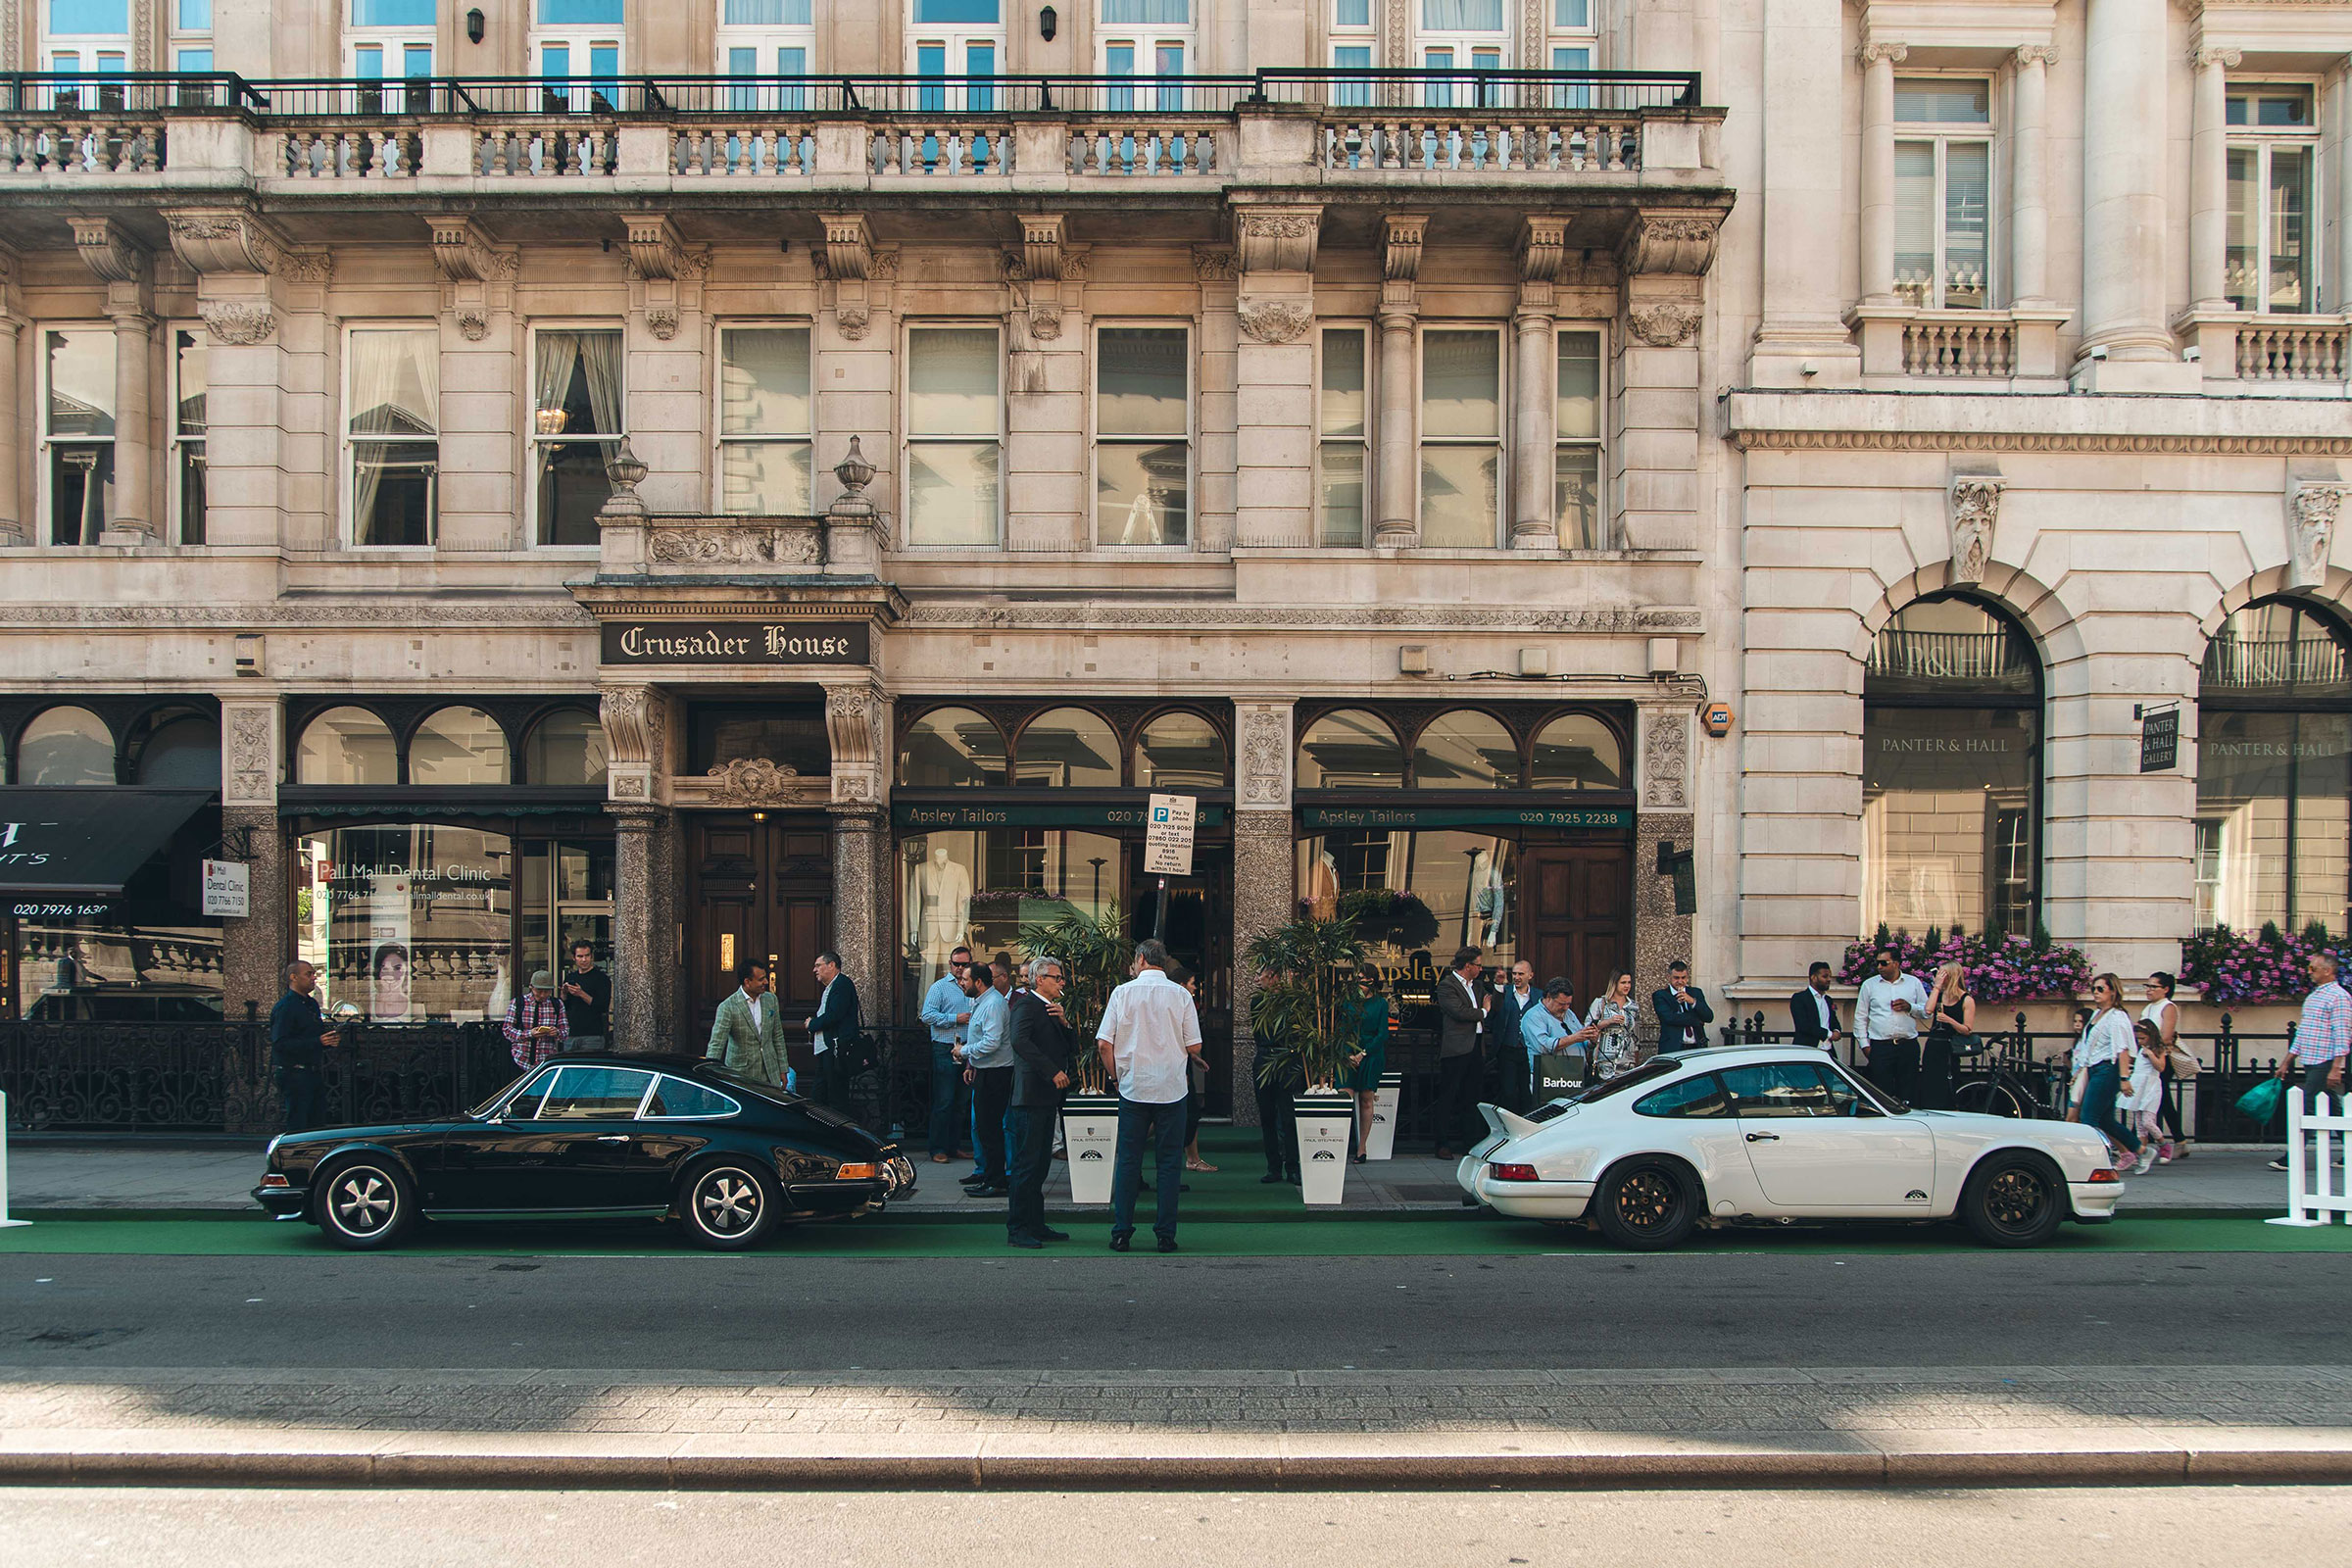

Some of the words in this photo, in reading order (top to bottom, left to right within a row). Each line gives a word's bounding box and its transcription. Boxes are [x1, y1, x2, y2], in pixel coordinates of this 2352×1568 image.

[620, 626, 752, 657] Crusader
[762, 625, 850, 659] House
[2145, 718, 2175, 735] PANTER
[1882, 738, 1945, 752] PANTER
[1948, 738, 1961, 752] &
[1966, 738, 2009, 752] HALL
[2143, 739, 2150, 751] &
[2152, 735, 2174, 750] HALL
[2210, 742, 2275, 756] PANTER
[2276, 742, 2288, 756] &
[2293, 743, 2335, 756] HALL
[2143, 751, 2174, 764] GALLERY
[908, 808, 956, 826] Apsley
[961, 808, 1006, 822] Tailors
[1106, 810, 1132, 822] 020
[1318, 809, 1365, 826] Apsley
[1369, 809, 1416, 823] Tailors
[1520, 812, 1544, 822] 020
[1548, 812, 1581, 823] 7925
[1586, 813, 1618, 824] 2238
[319, 863, 346, 880] Pall
[352, 863, 382, 880] Mall
[389, 864, 440, 880] Dental
[447, 864, 491, 881] Clinic
[207, 878, 226, 891] Dental
[227, 879, 245, 892] Clinic
[207, 895, 218, 906] 020
[218, 896, 231, 906] 7766
[231, 896, 245, 906] 7150
[317, 890, 334, 900] 020
[337, 890, 361, 900] 7766
[13, 904, 39, 915] 020
[40, 904, 74, 915] 7976
[1543, 1077, 1583, 1089] Barbour
